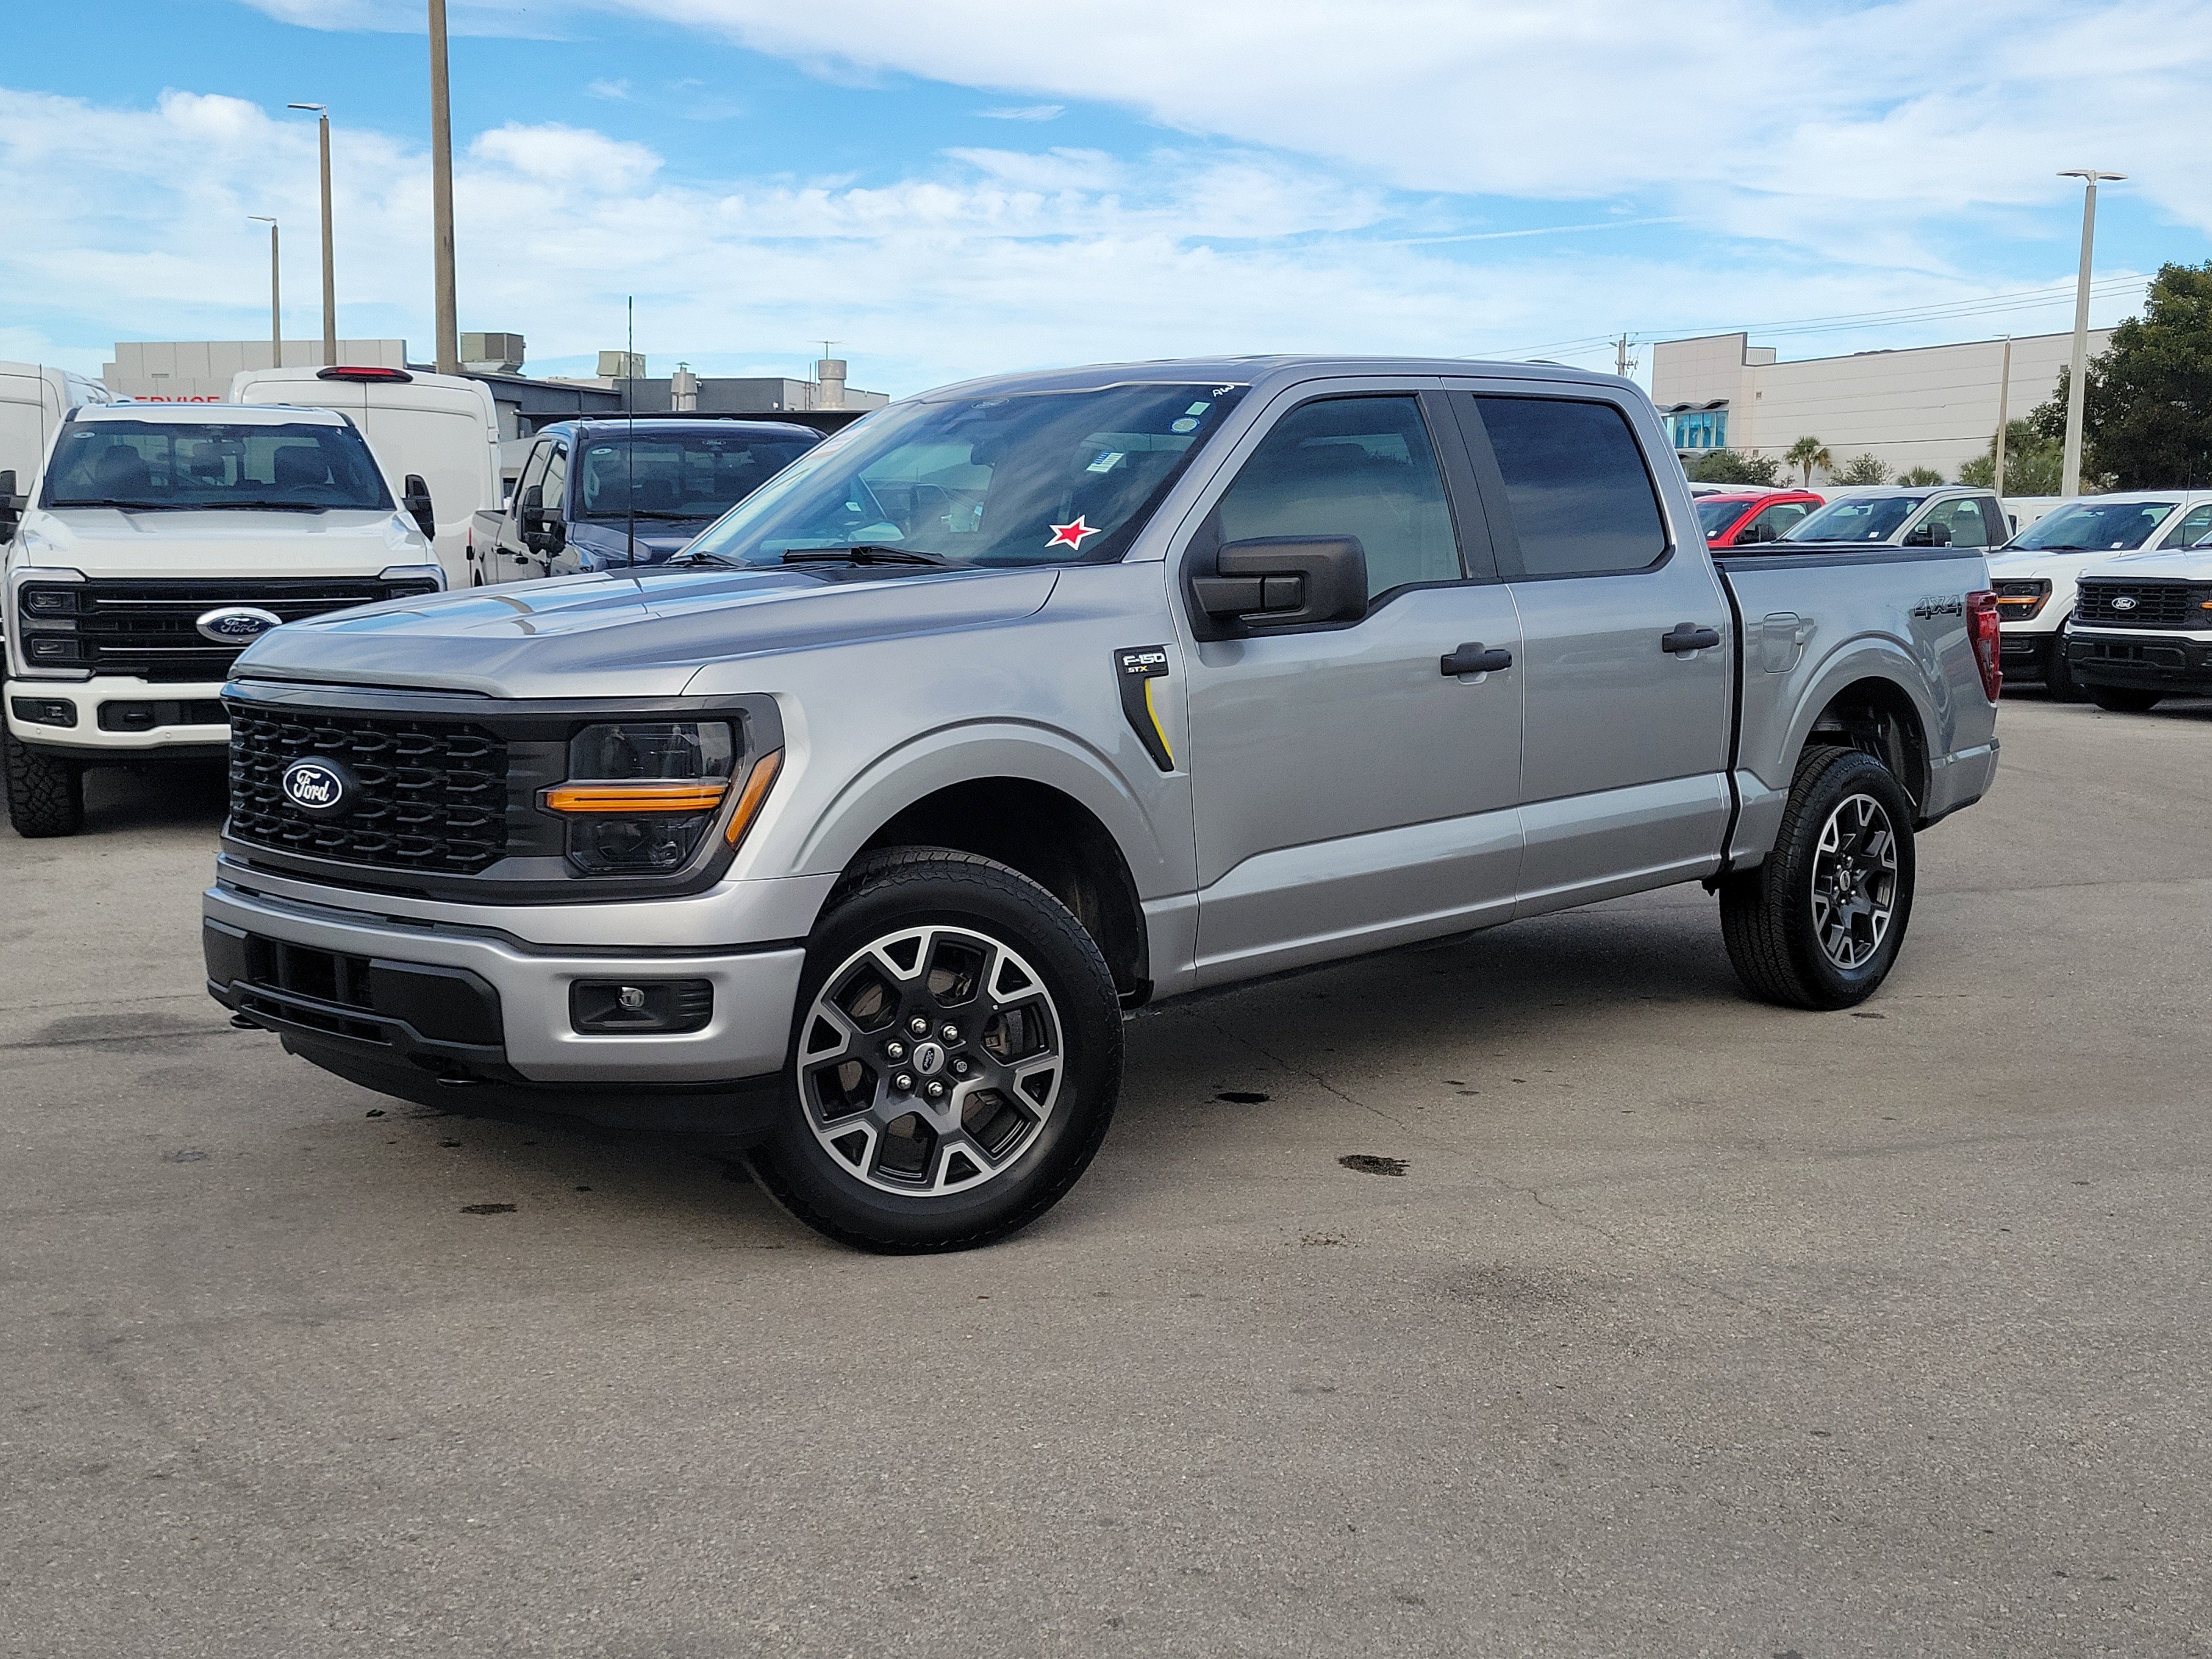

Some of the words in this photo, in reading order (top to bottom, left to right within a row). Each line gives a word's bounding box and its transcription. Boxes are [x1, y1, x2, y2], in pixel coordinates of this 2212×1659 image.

[2116, 599, 2131, 607] Ford
[221, 617, 259, 633] Ford
[1123, 652, 1166, 665] F-150
[294, 769, 330, 802] Ford
[923, 1050, 934, 1068] Ford
